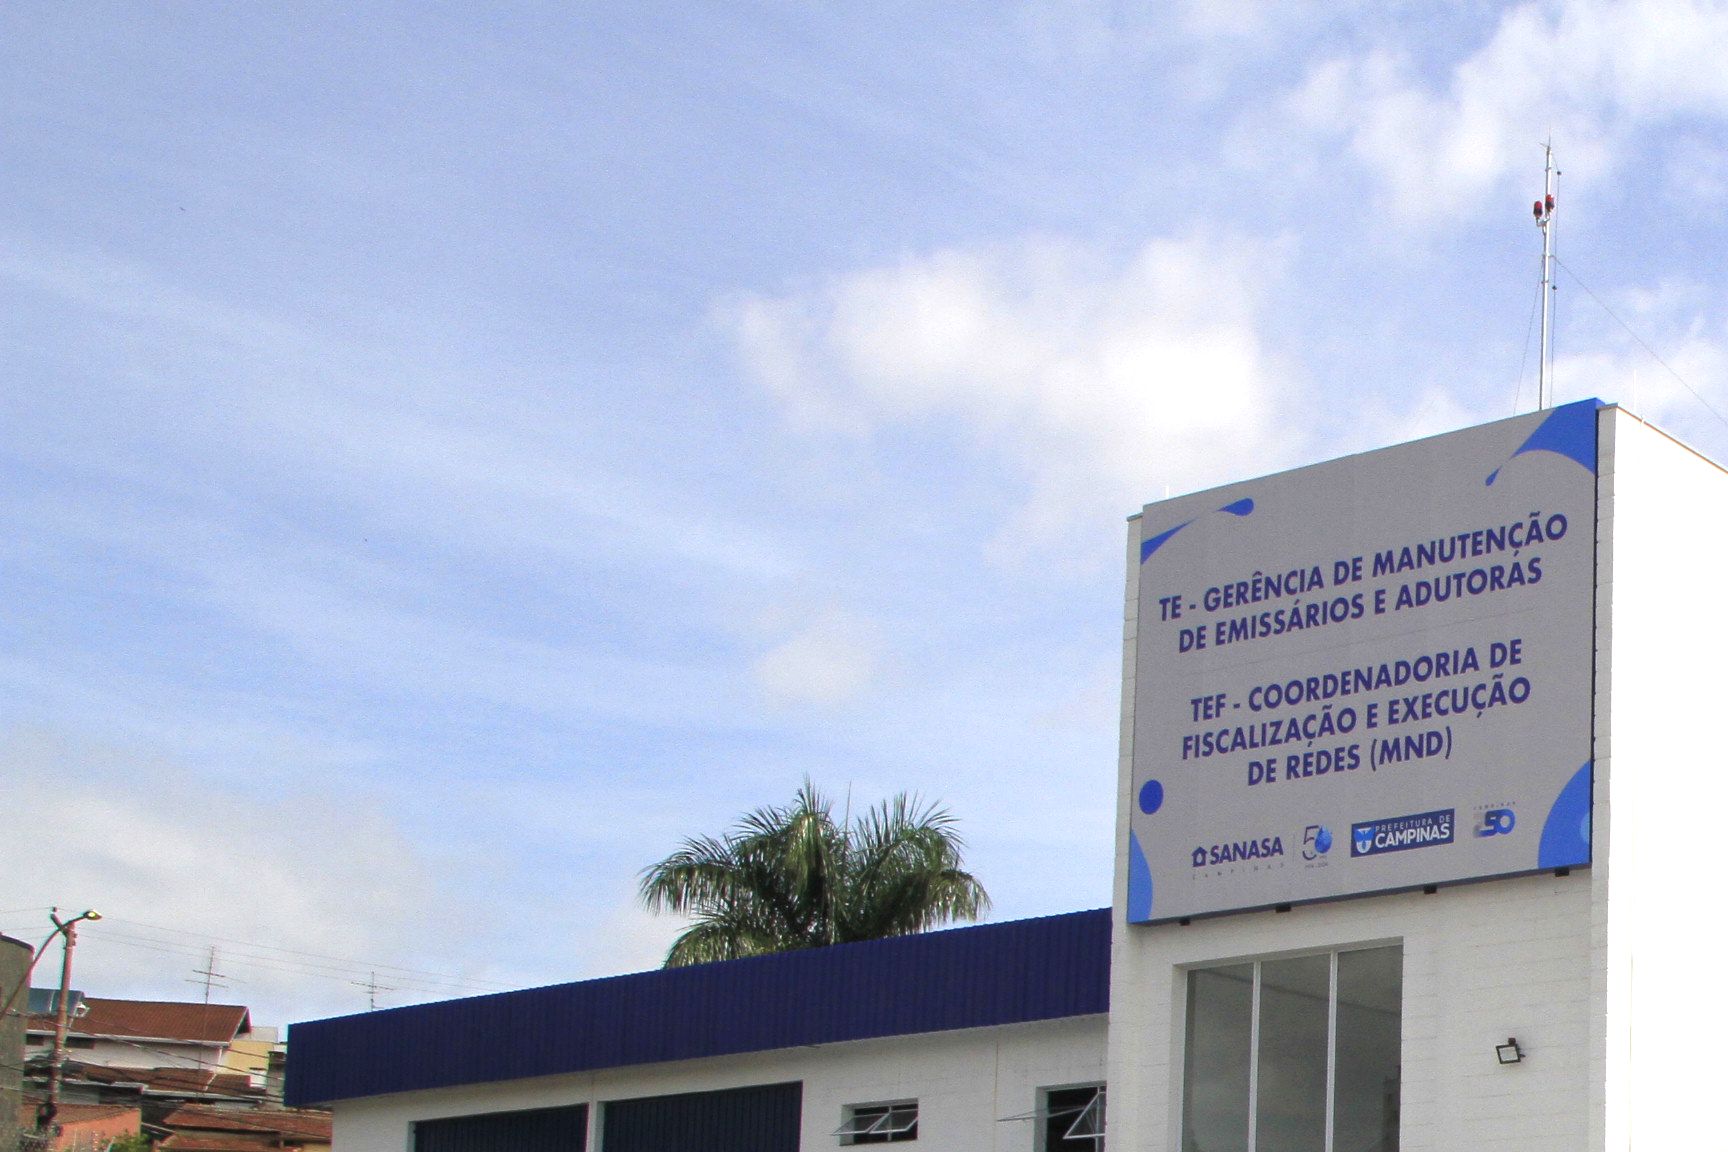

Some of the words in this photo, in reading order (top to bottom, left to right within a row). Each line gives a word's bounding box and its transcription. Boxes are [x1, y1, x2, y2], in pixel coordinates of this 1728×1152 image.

[1158, 594, 1182, 622] TE
[1203, 566, 1324, 612] GERÊNCIA
[1333, 556, 1363, 586] DE
[1372, 510, 1568, 578] MANUTENÇÃO
[1179, 625, 1207, 653] DE
[1215, 593, 1364, 646] EMISSÁRIOS
[1374, 588, 1386, 615] E
[1394, 556, 1543, 611] ADUTORAS
[1190, 693, 1227, 722] TEF
[1248, 647, 1480, 712] COORDENADORIA
[1490, 638, 1522, 669] DE
[1182, 704, 1357, 760] FISCALIZAÇÃO
[1366, 703, 1378, 729] E
[1388, 673, 1531, 726] EXECUÇÃO
[1248, 758, 1277, 786] DE
[1286, 744, 1361, 780] REDES
[1370, 726, 1452, 772] (MND)
[1209, 836, 1284, 865] SANASA
[1375, 815, 1433, 832] PREFEITURA
[1438, 814, 1451, 824] DE
[1375, 823, 1450, 849] CAMPINAS
